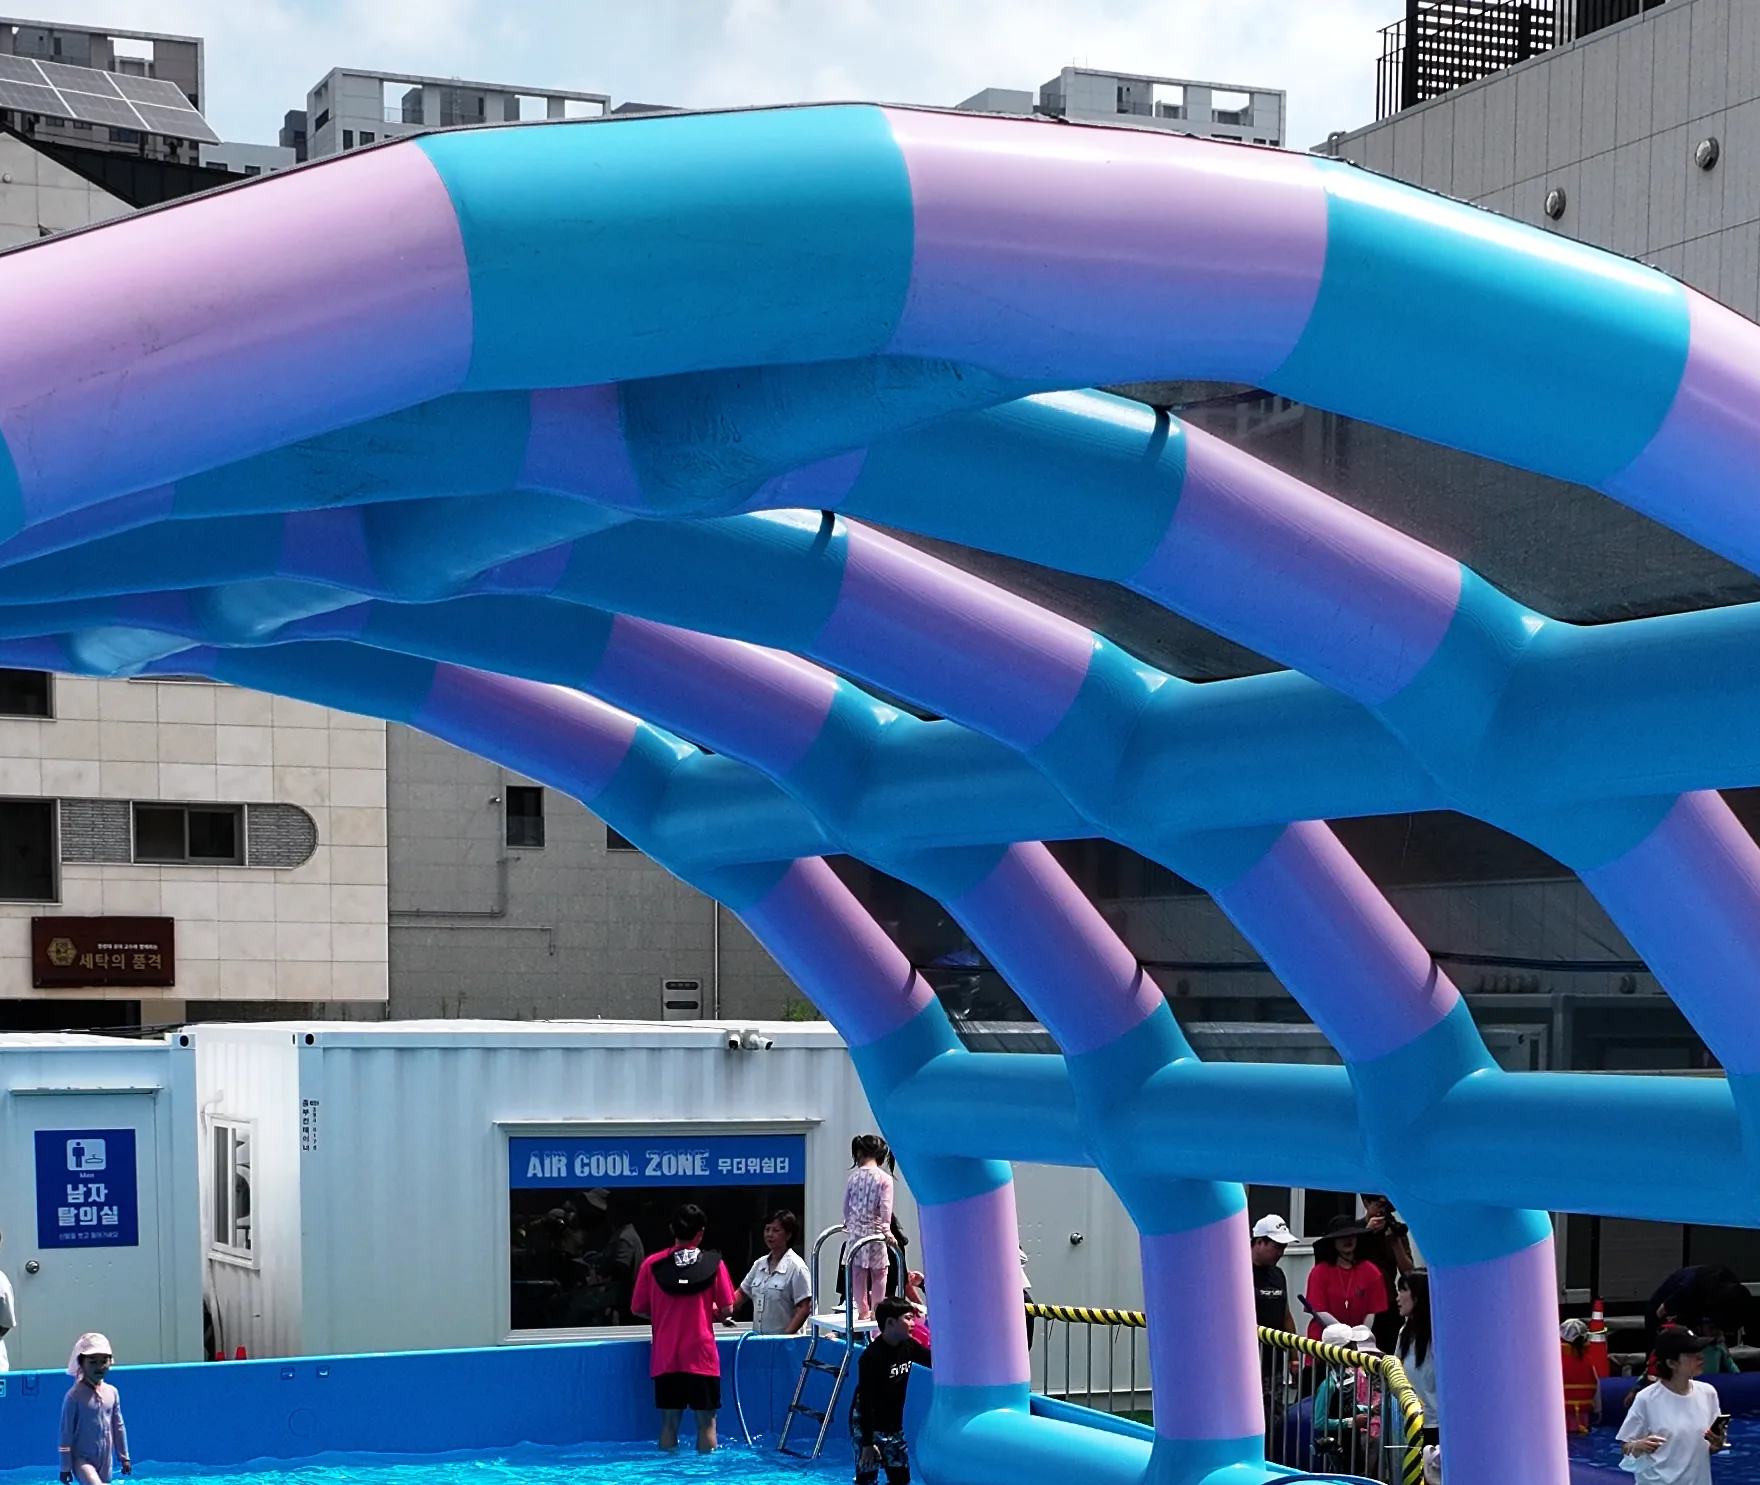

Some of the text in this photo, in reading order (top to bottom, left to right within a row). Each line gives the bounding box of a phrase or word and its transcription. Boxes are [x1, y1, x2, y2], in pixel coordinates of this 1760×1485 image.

[80, 953, 161, 970] 세탁의 품격
[527, 1149, 790, 1178] AIR COOL ZONE 무더위쉼터
[67, 1183, 108, 1203] 남자
[58, 1205, 119, 1226] 탈의실
